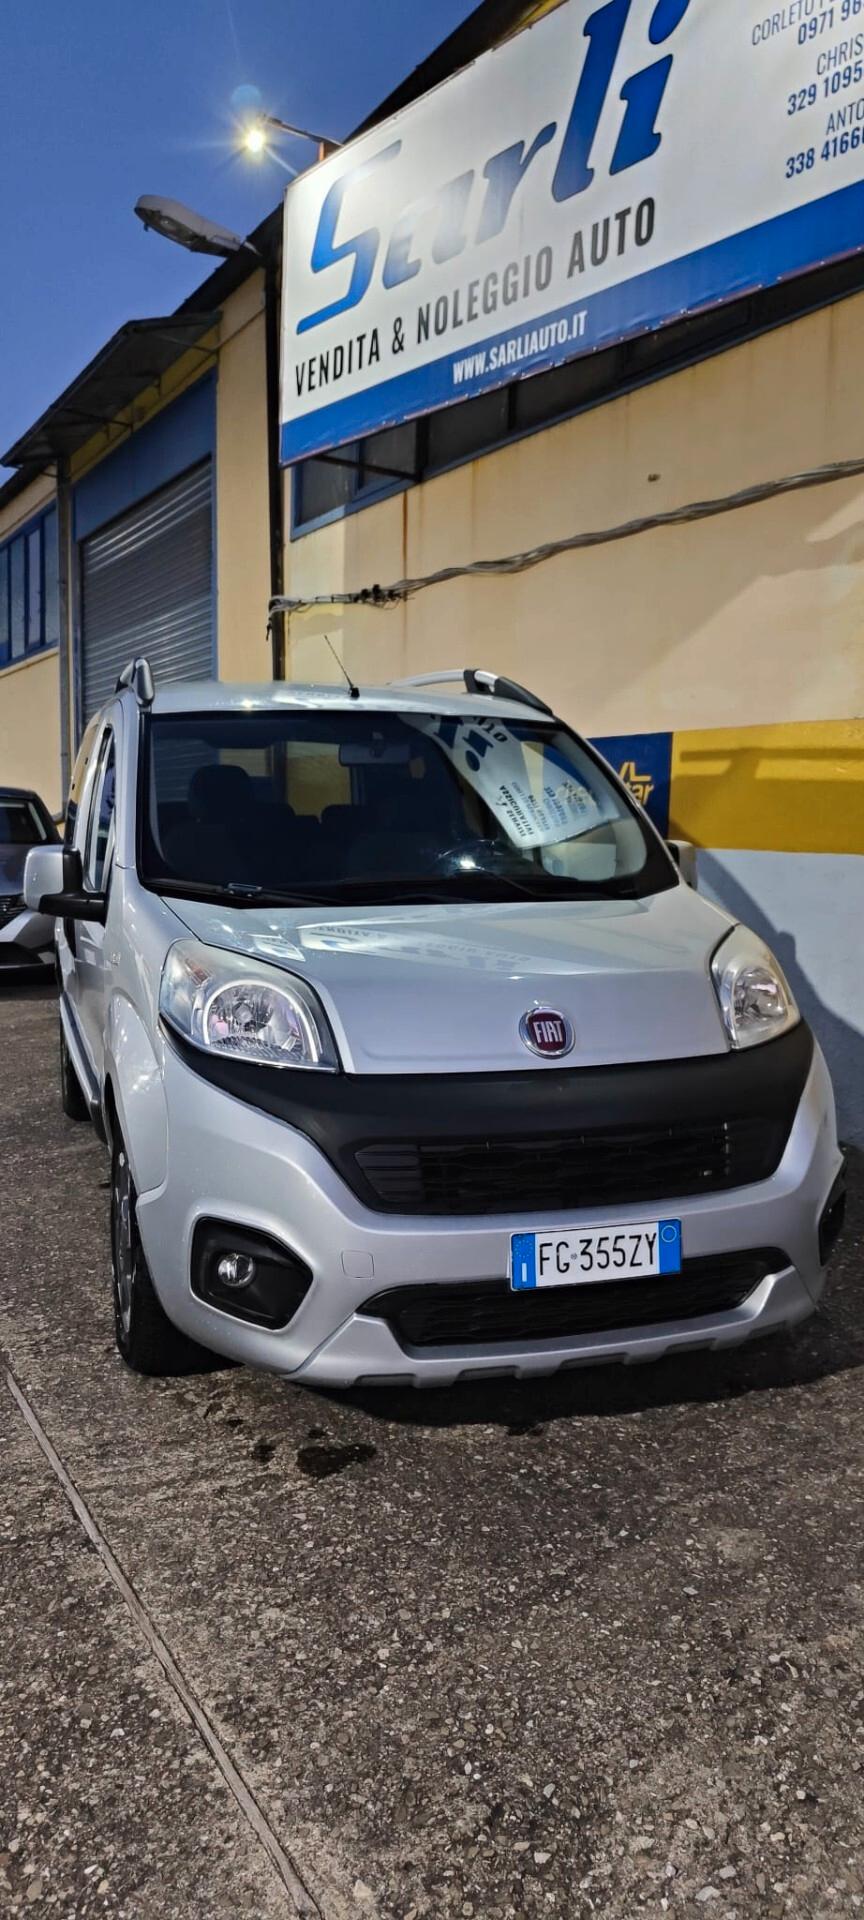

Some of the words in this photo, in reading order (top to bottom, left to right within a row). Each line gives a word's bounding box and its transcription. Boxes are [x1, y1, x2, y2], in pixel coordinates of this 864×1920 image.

[798, 7, 834, 45] 0971
[817, 33, 863, 75] CHRIS
[787, 83, 817, 115] 329
[823, 60, 863, 98] 1095
[296, 0, 690, 335] Sarli
[786, 147, 815, 178] 338
[820, 126, 864, 161] 4166
[295, 333, 381, 397] VENDITA
[392, 317, 405, 355] &
[416, 245, 554, 344] NOLEGGIO
[567, 197, 655, 279] AUTO
[452, 309, 588, 385] WWW.SARLIAUTO.IT
[533, 1020, 562, 1044] FIAT
